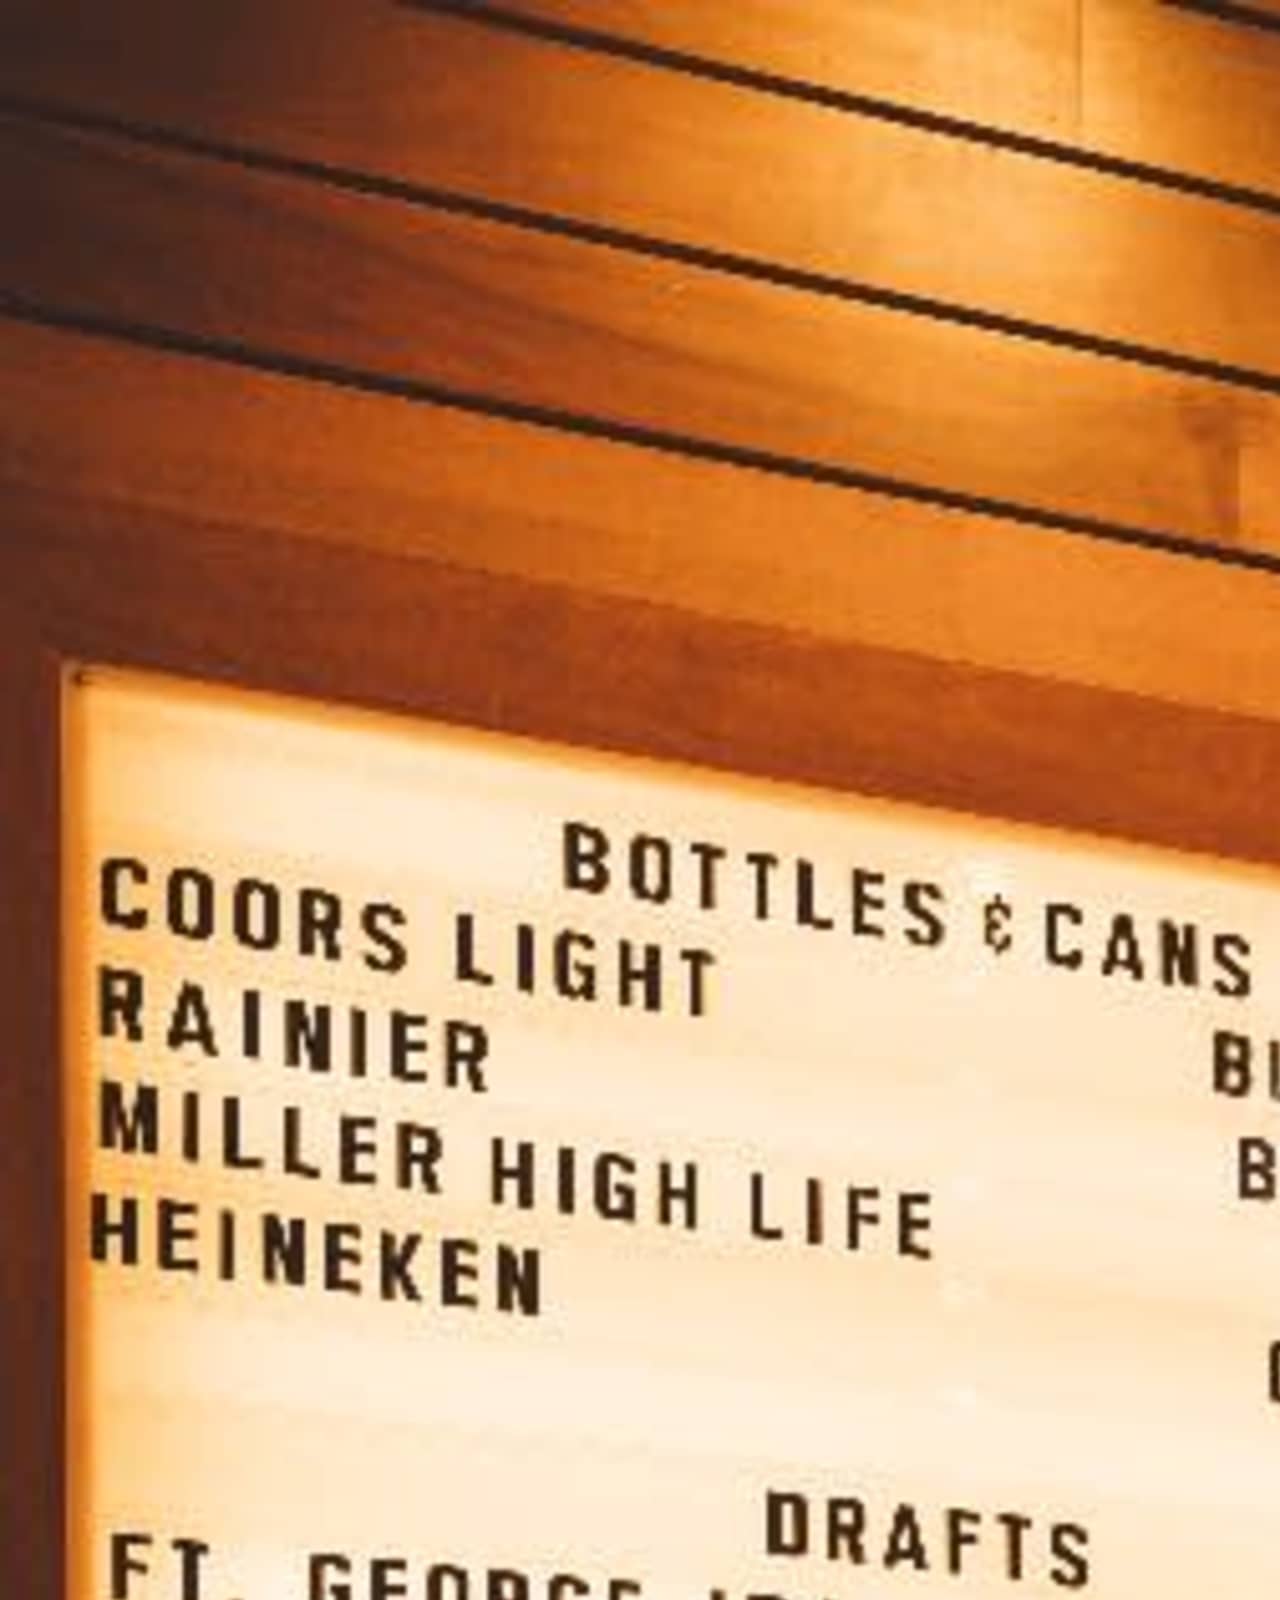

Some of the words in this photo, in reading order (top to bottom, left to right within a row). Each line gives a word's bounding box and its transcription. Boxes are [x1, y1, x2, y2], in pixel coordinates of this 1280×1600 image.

[99, 857, 408, 975] COORS
[455, 912, 716, 1018] LIGHT
[562, 821, 946, 949] BOTTLES
[983, 893, 1013, 956] &
[1044, 902, 1252, 1000] CANS
[97, 964, 489, 1094] RAINIER
[98, 1078, 444, 1196] MILLER
[490, 1136, 698, 1231] HIGH
[750, 1171, 932, 1261] LIFE
[90, 1193, 540, 1317] HEINEKEN
[765, 1489, 1089, 1591] DRAFTS
